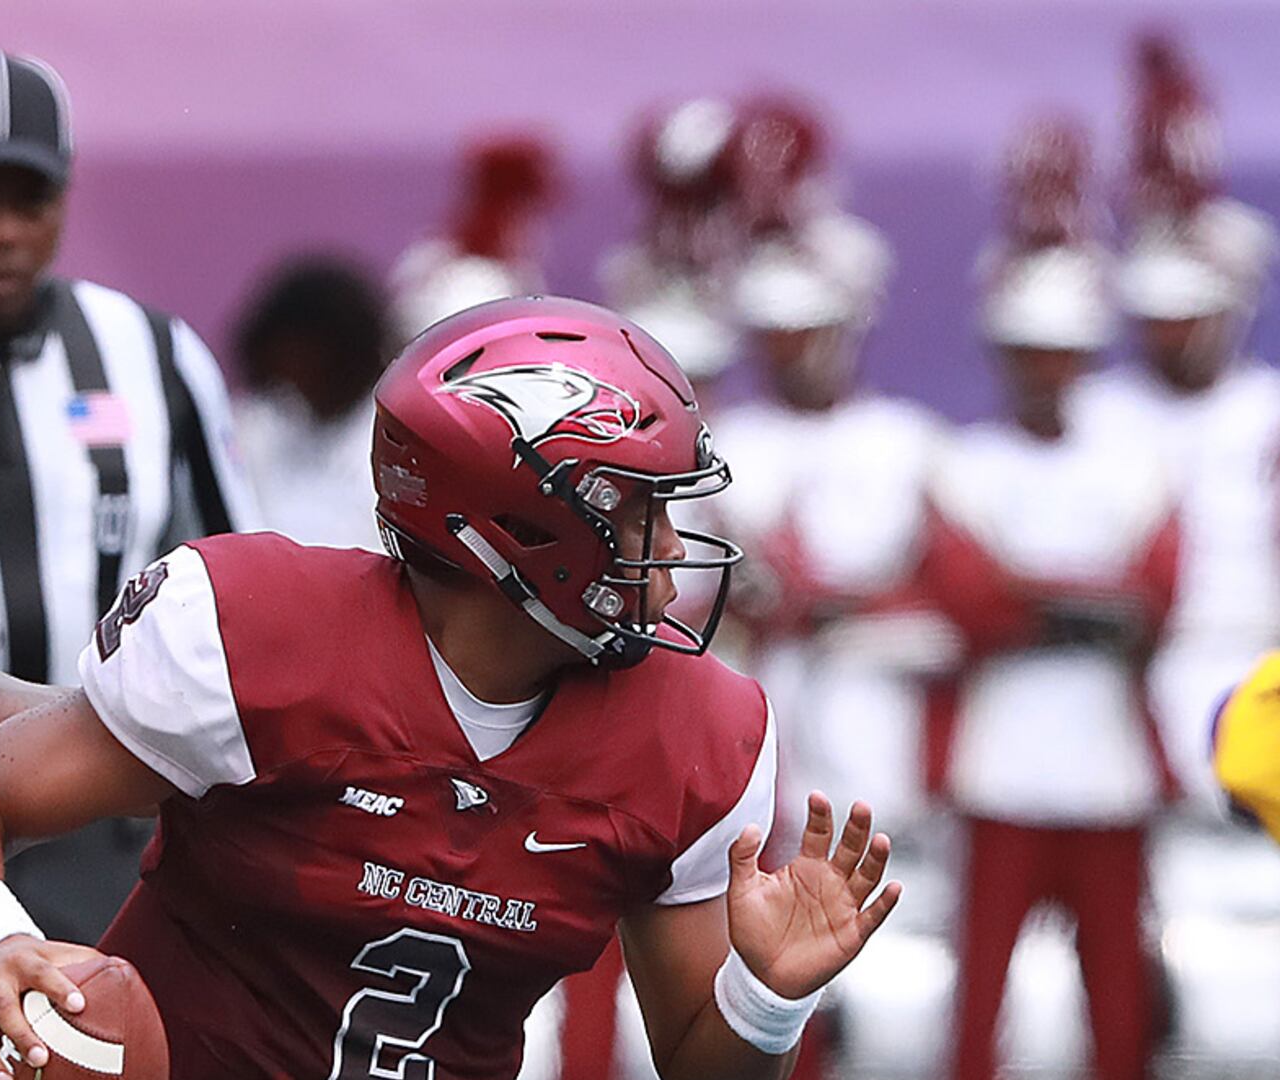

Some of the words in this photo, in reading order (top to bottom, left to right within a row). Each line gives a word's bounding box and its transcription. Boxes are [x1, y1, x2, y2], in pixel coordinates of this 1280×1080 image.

[95, 560, 169, 664] 2
[338, 786, 405, 817] MEAC
[357, 861, 405, 899] NC
[404, 876, 538, 932] CENTRAL
